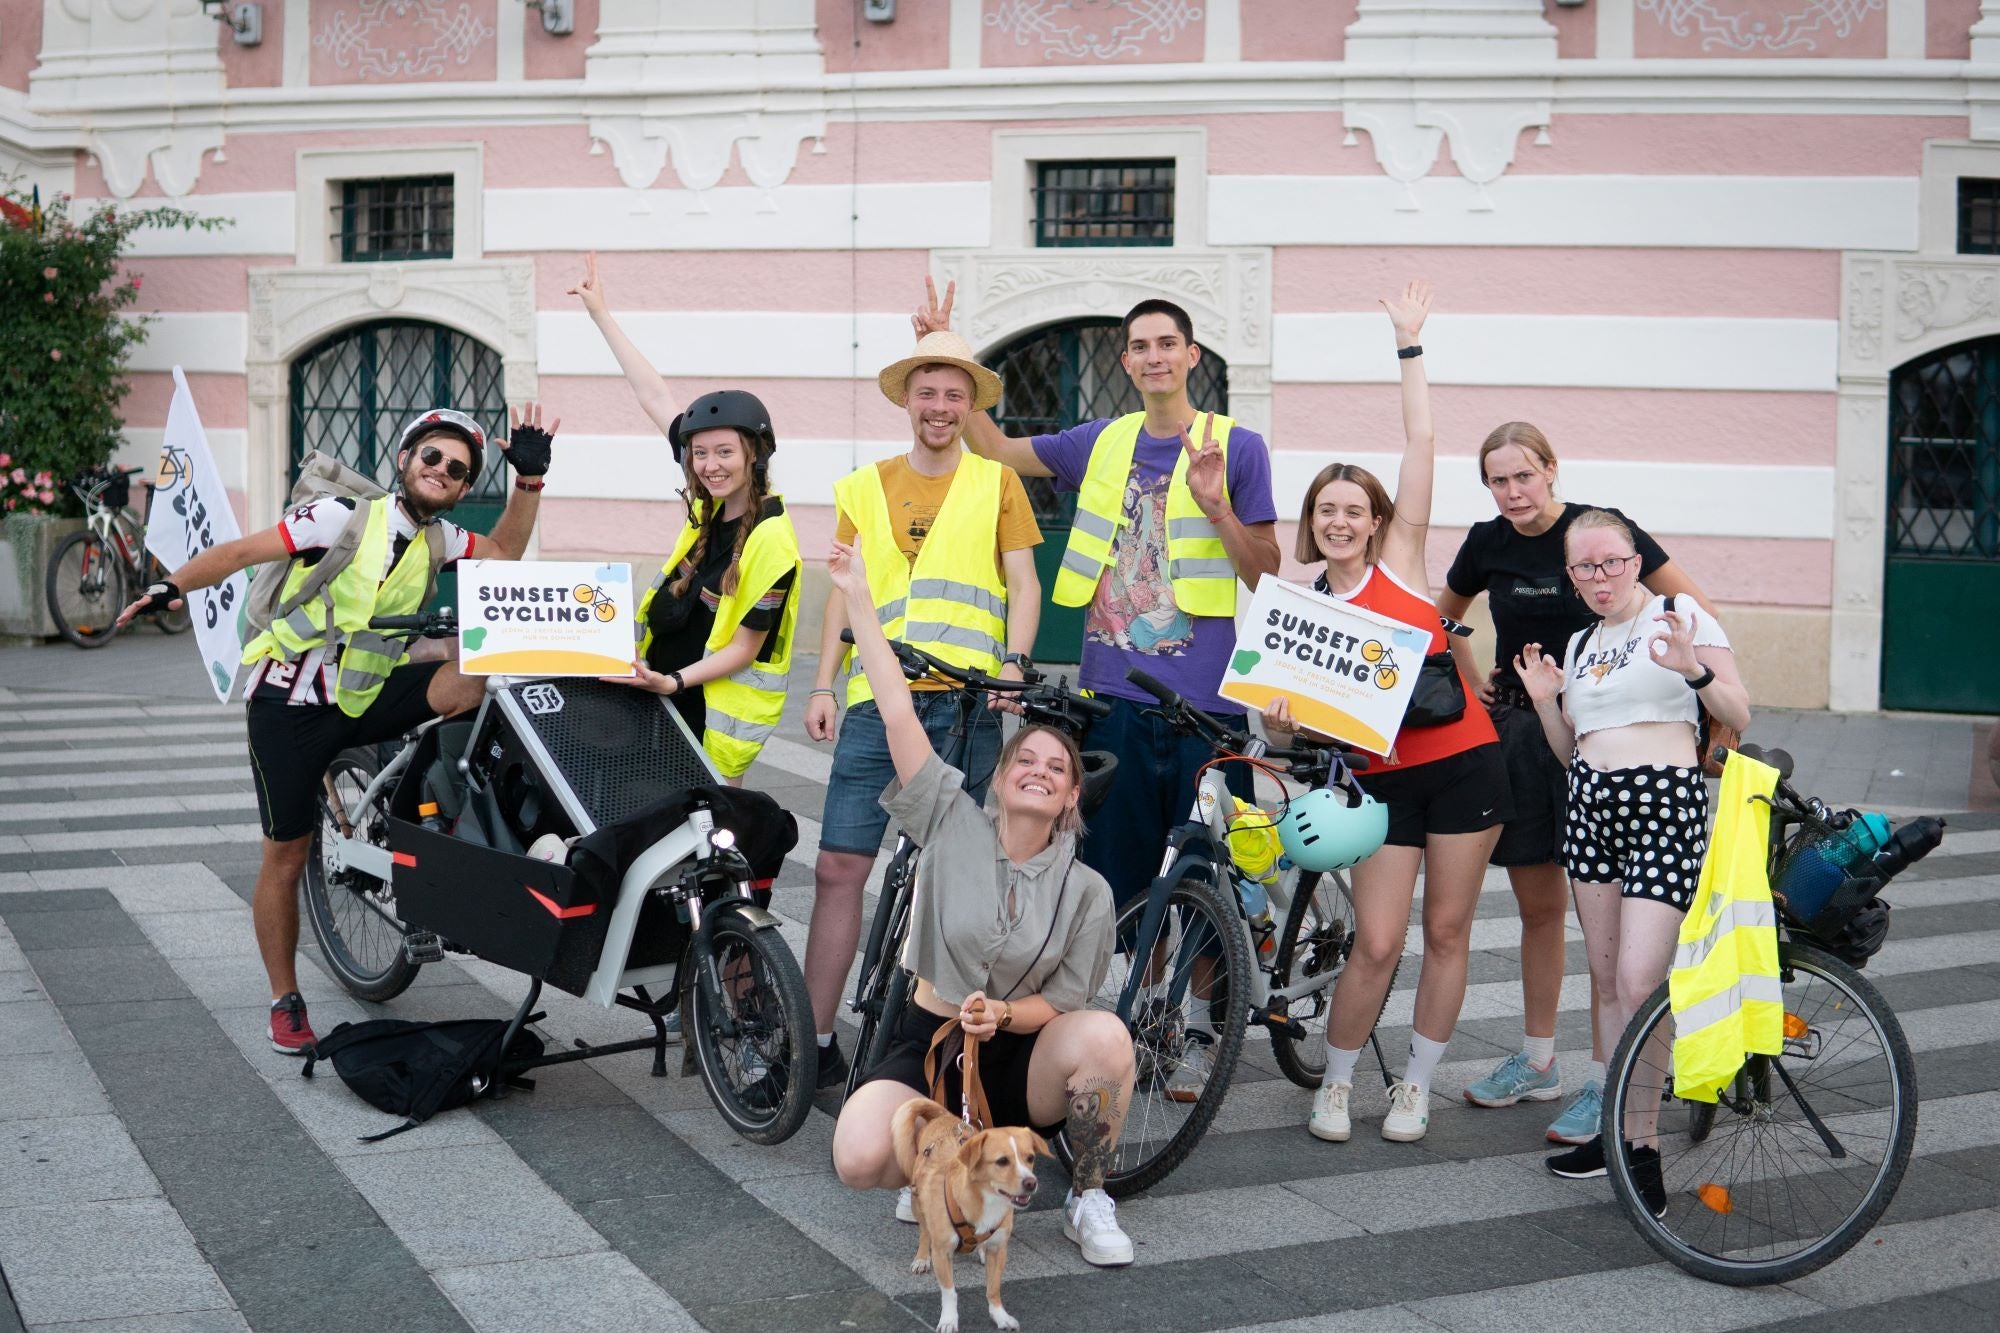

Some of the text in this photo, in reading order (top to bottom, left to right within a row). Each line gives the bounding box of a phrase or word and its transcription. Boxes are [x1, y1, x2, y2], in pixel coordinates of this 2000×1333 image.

[479, 586, 569, 602] SUNSET
[484, 606, 589, 622] CYCLING
[1267, 609, 1359, 653] SUNSET
[1265, 632, 1370, 681] CYCLING
